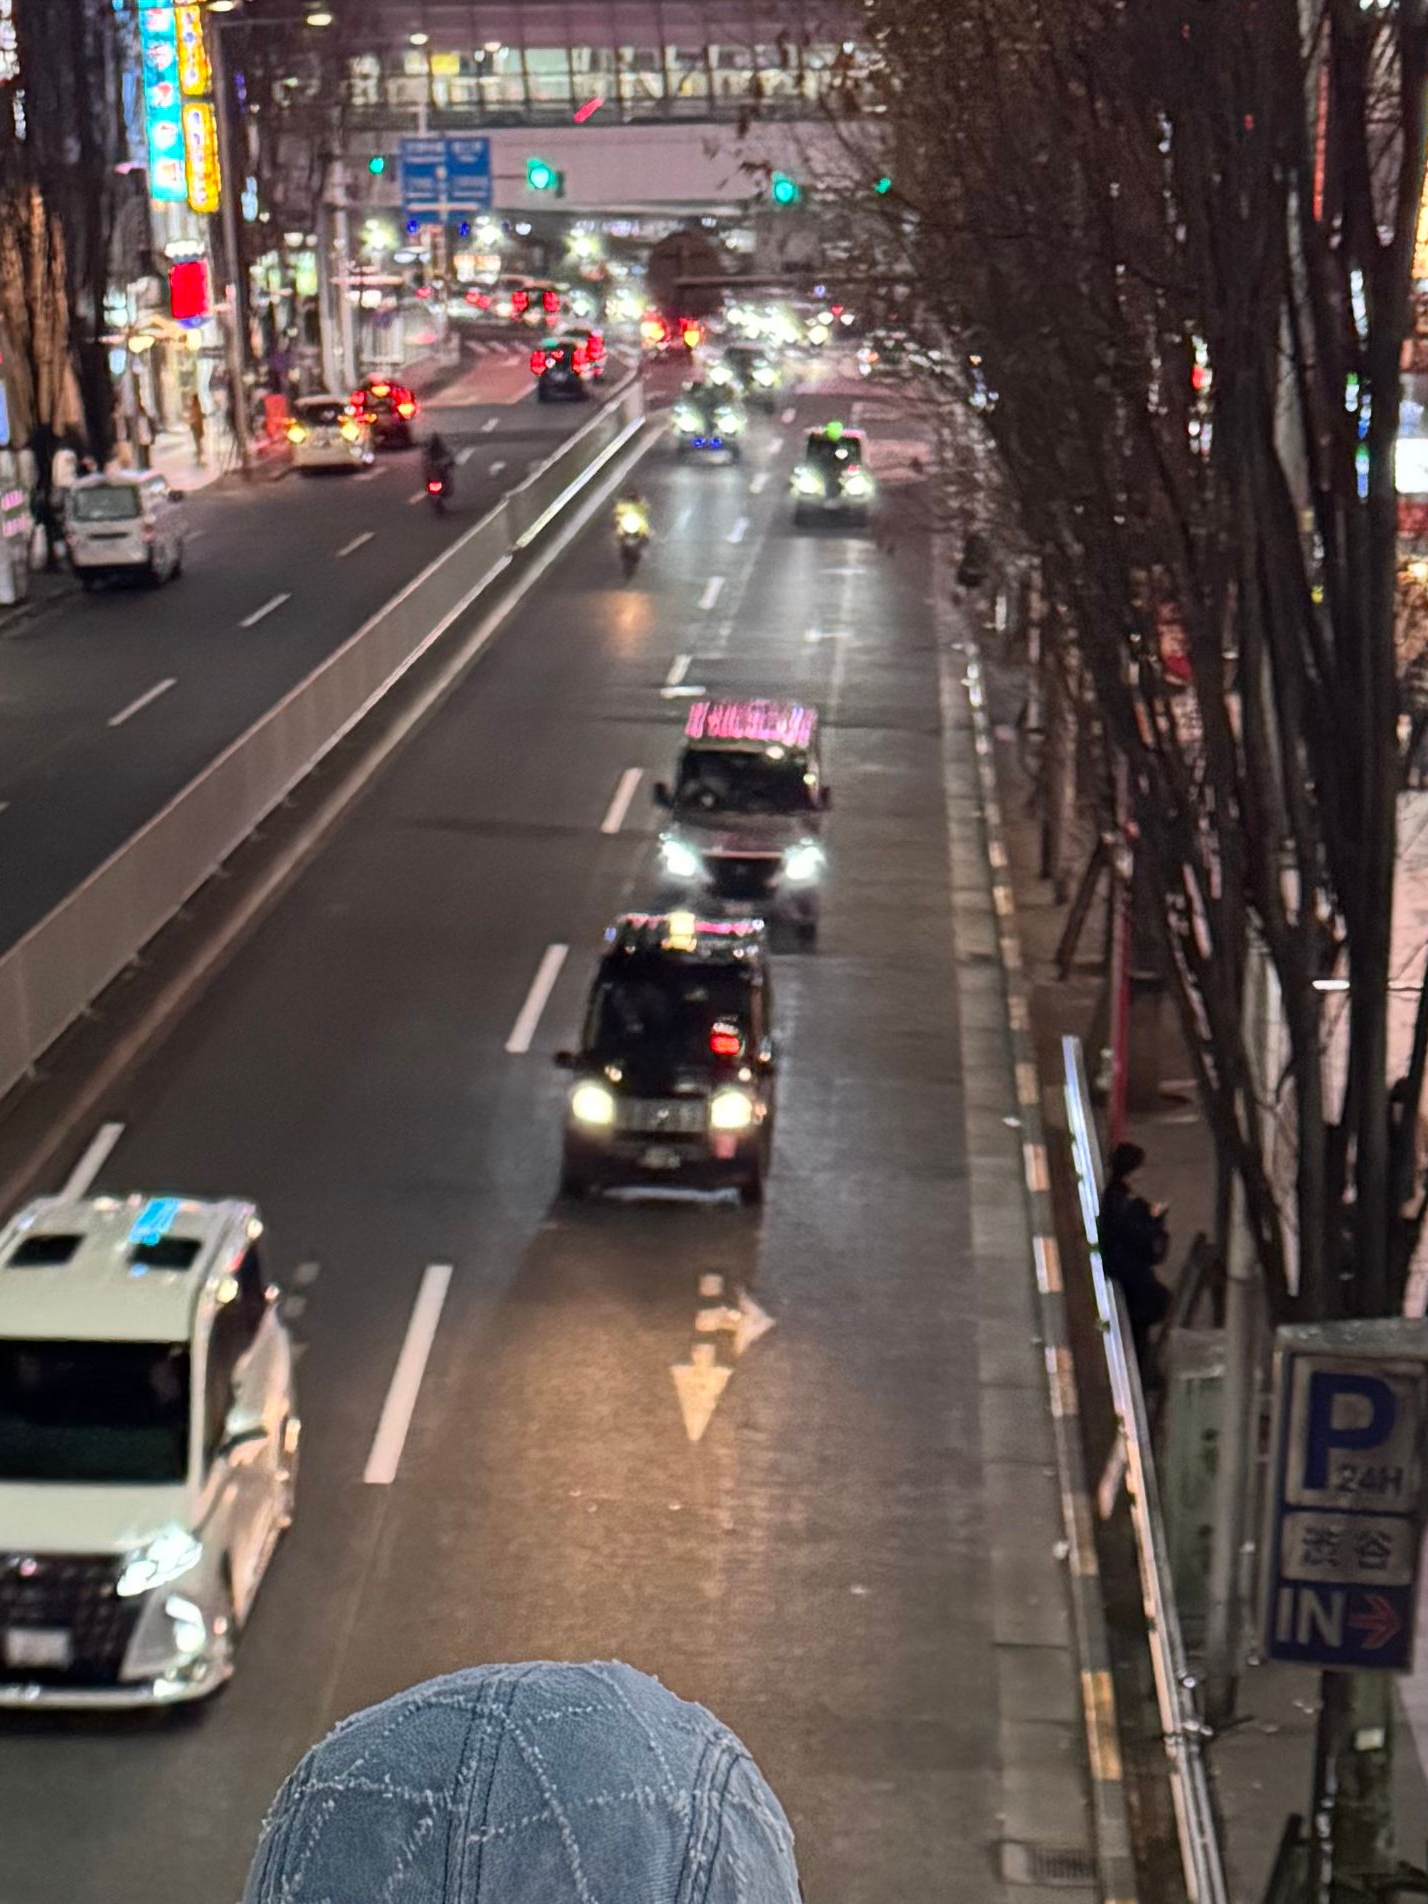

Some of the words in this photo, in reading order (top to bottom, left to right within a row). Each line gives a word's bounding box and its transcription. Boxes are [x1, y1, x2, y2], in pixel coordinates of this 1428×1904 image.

[1302, 1371, 1397, 1490] P
[1338, 1464, 1404, 1495] 24H
[1276, 1587, 1348, 1648] IN
